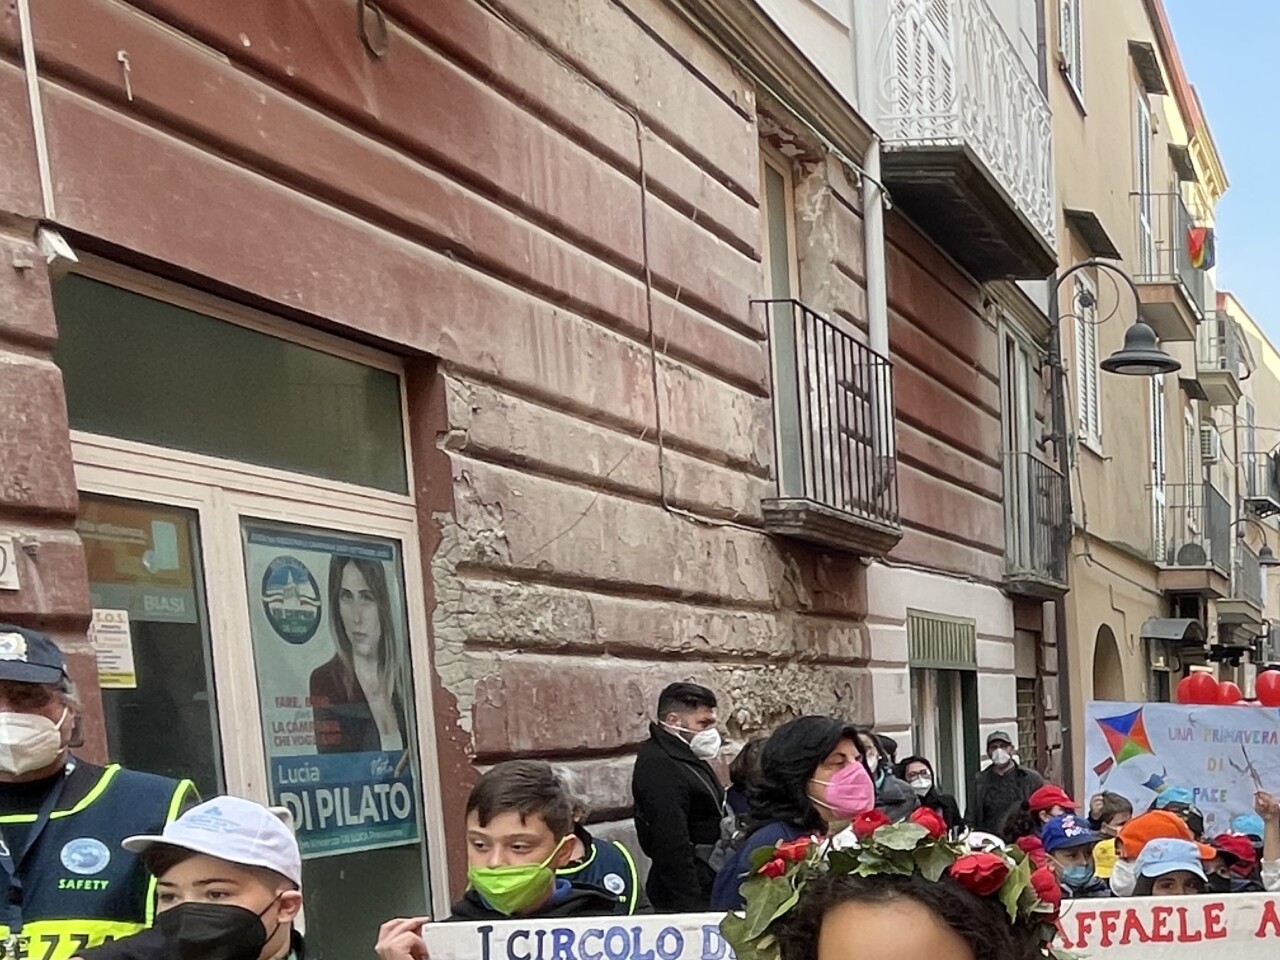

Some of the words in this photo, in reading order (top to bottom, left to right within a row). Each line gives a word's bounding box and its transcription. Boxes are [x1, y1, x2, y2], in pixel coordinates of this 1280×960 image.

[1167, 727, 1194, 742] UNA
[278, 760, 321, 785] Lucia
[1192, 787, 1229, 805] PACE
[279, 790, 313, 832] DI
[315, 781, 412, 830] PILATO
[58, 878, 110, 891] SAFETY
